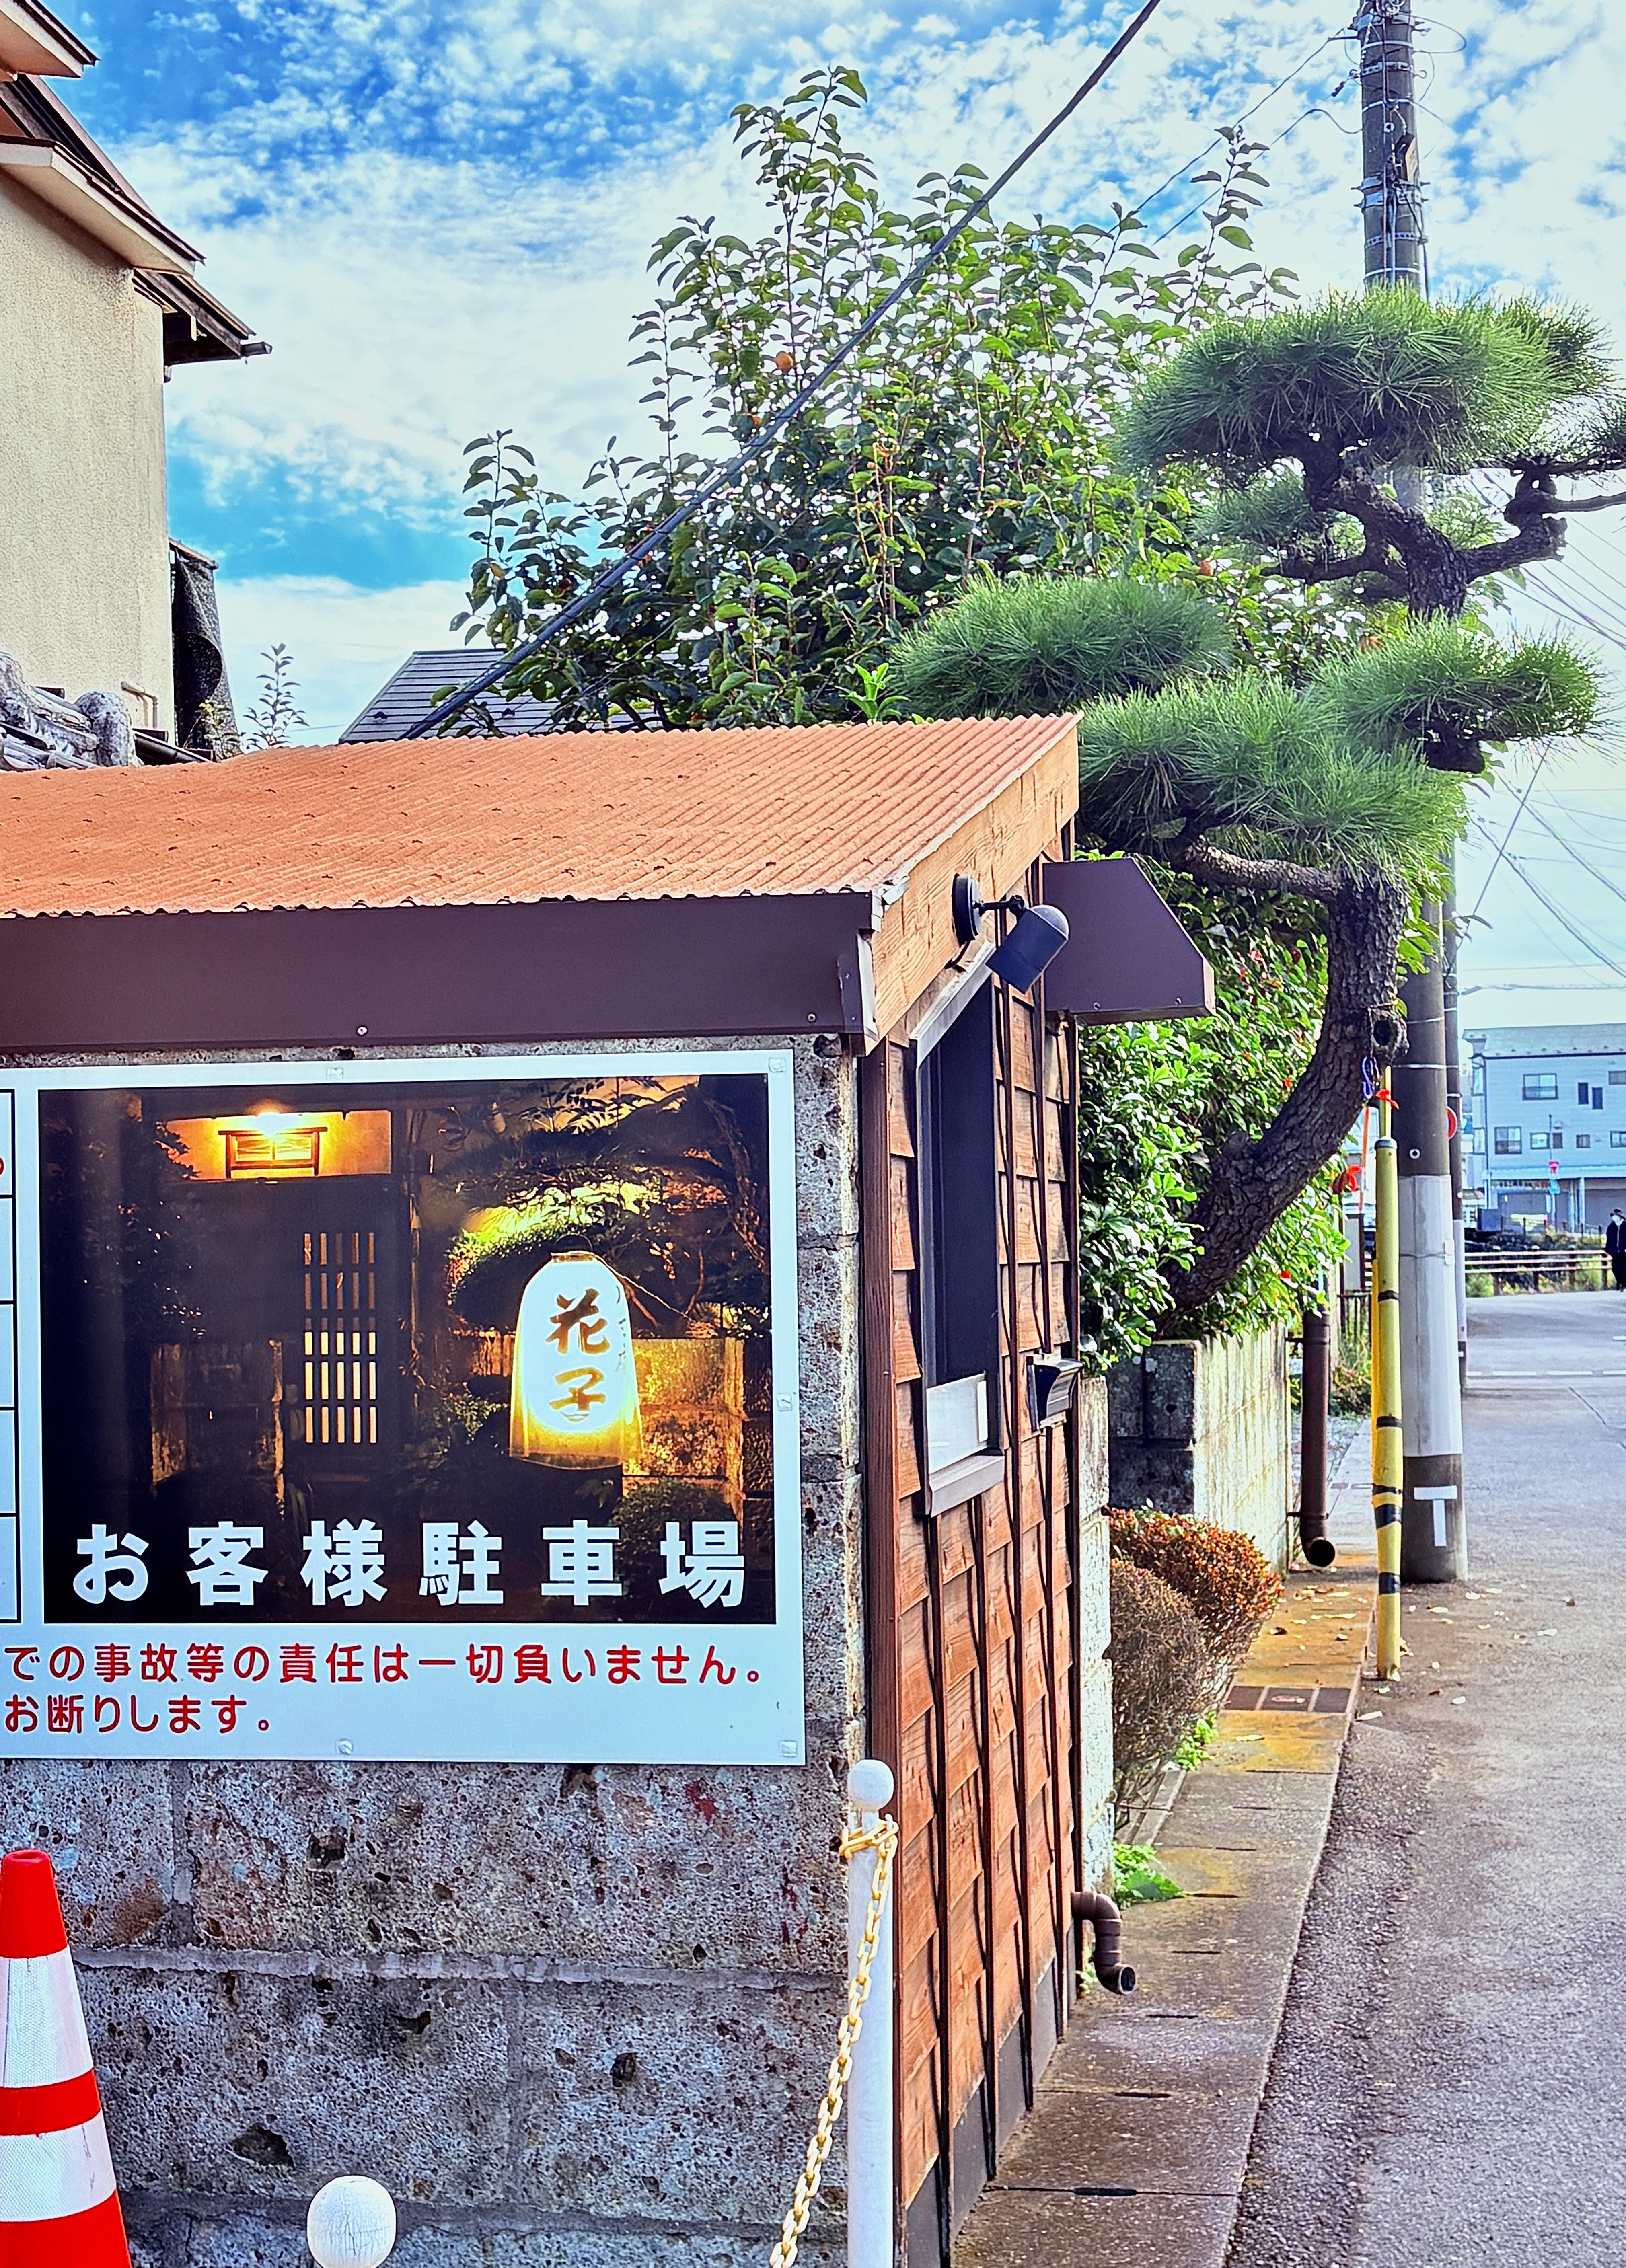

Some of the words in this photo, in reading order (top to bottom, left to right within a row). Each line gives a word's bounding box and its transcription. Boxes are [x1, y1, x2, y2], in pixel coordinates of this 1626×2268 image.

[545, 1288, 610, 1415] 花子
[73, 1518, 745, 1608] お客様駐車場
[4, 1643, 760, 1685] での事故等の責任は一切負いません。
[5, 1694, 270, 1734] お断りします。
